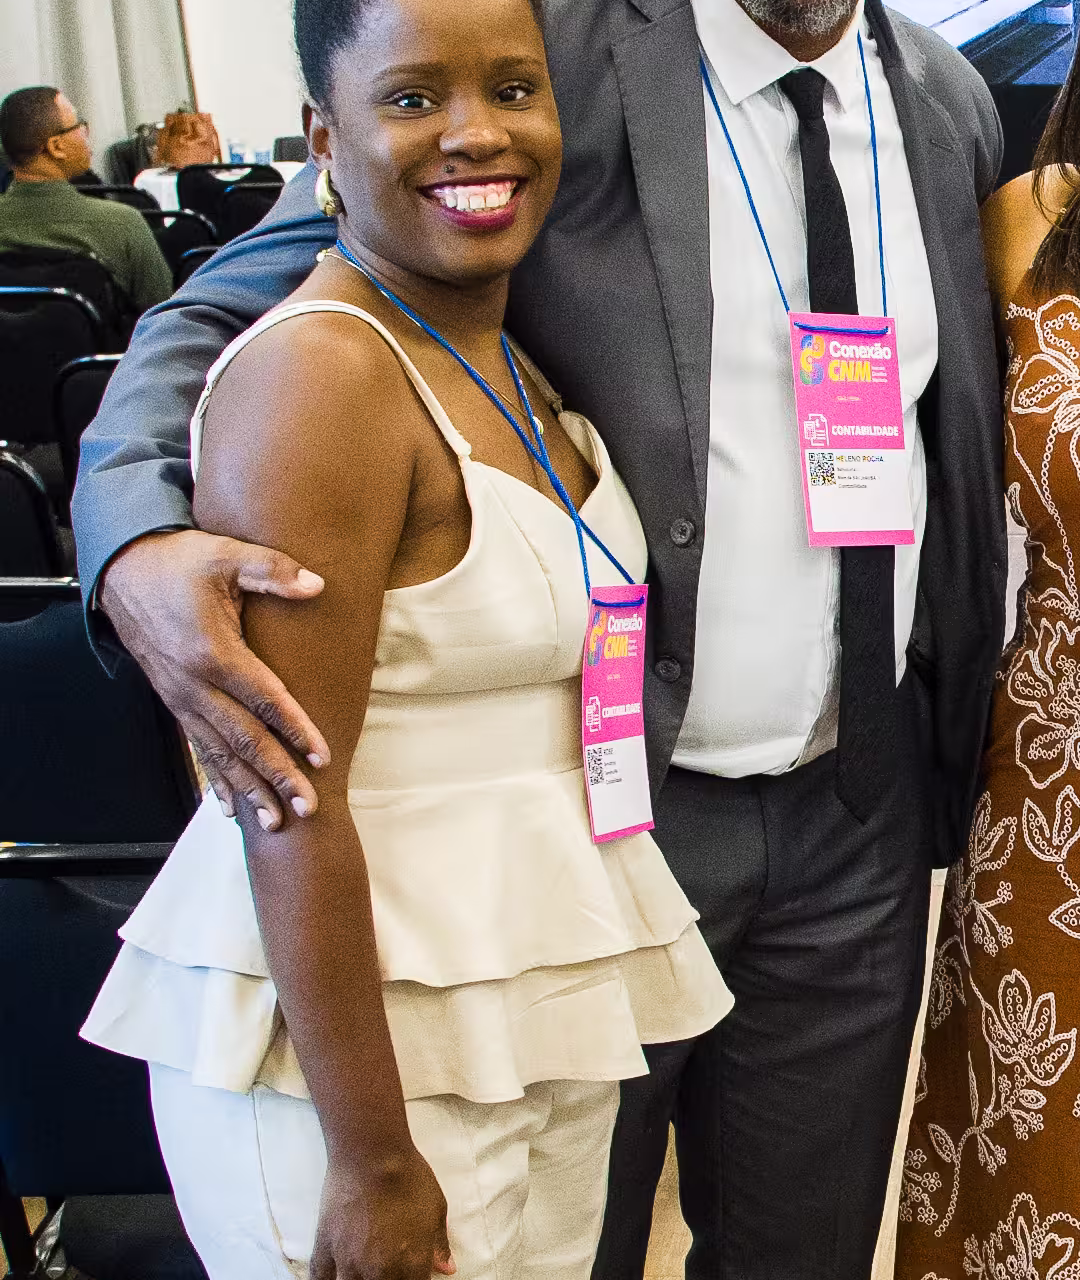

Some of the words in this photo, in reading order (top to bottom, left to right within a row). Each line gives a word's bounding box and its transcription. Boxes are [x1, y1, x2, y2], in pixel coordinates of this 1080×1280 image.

[829, 340, 892, 360] Conexão
[828, 359, 872, 383] CNM
[831, 425, 899, 437] CONTABILIDADE
[607, 612, 643, 634] Conexão
[604, 634, 629, 659] CNM
